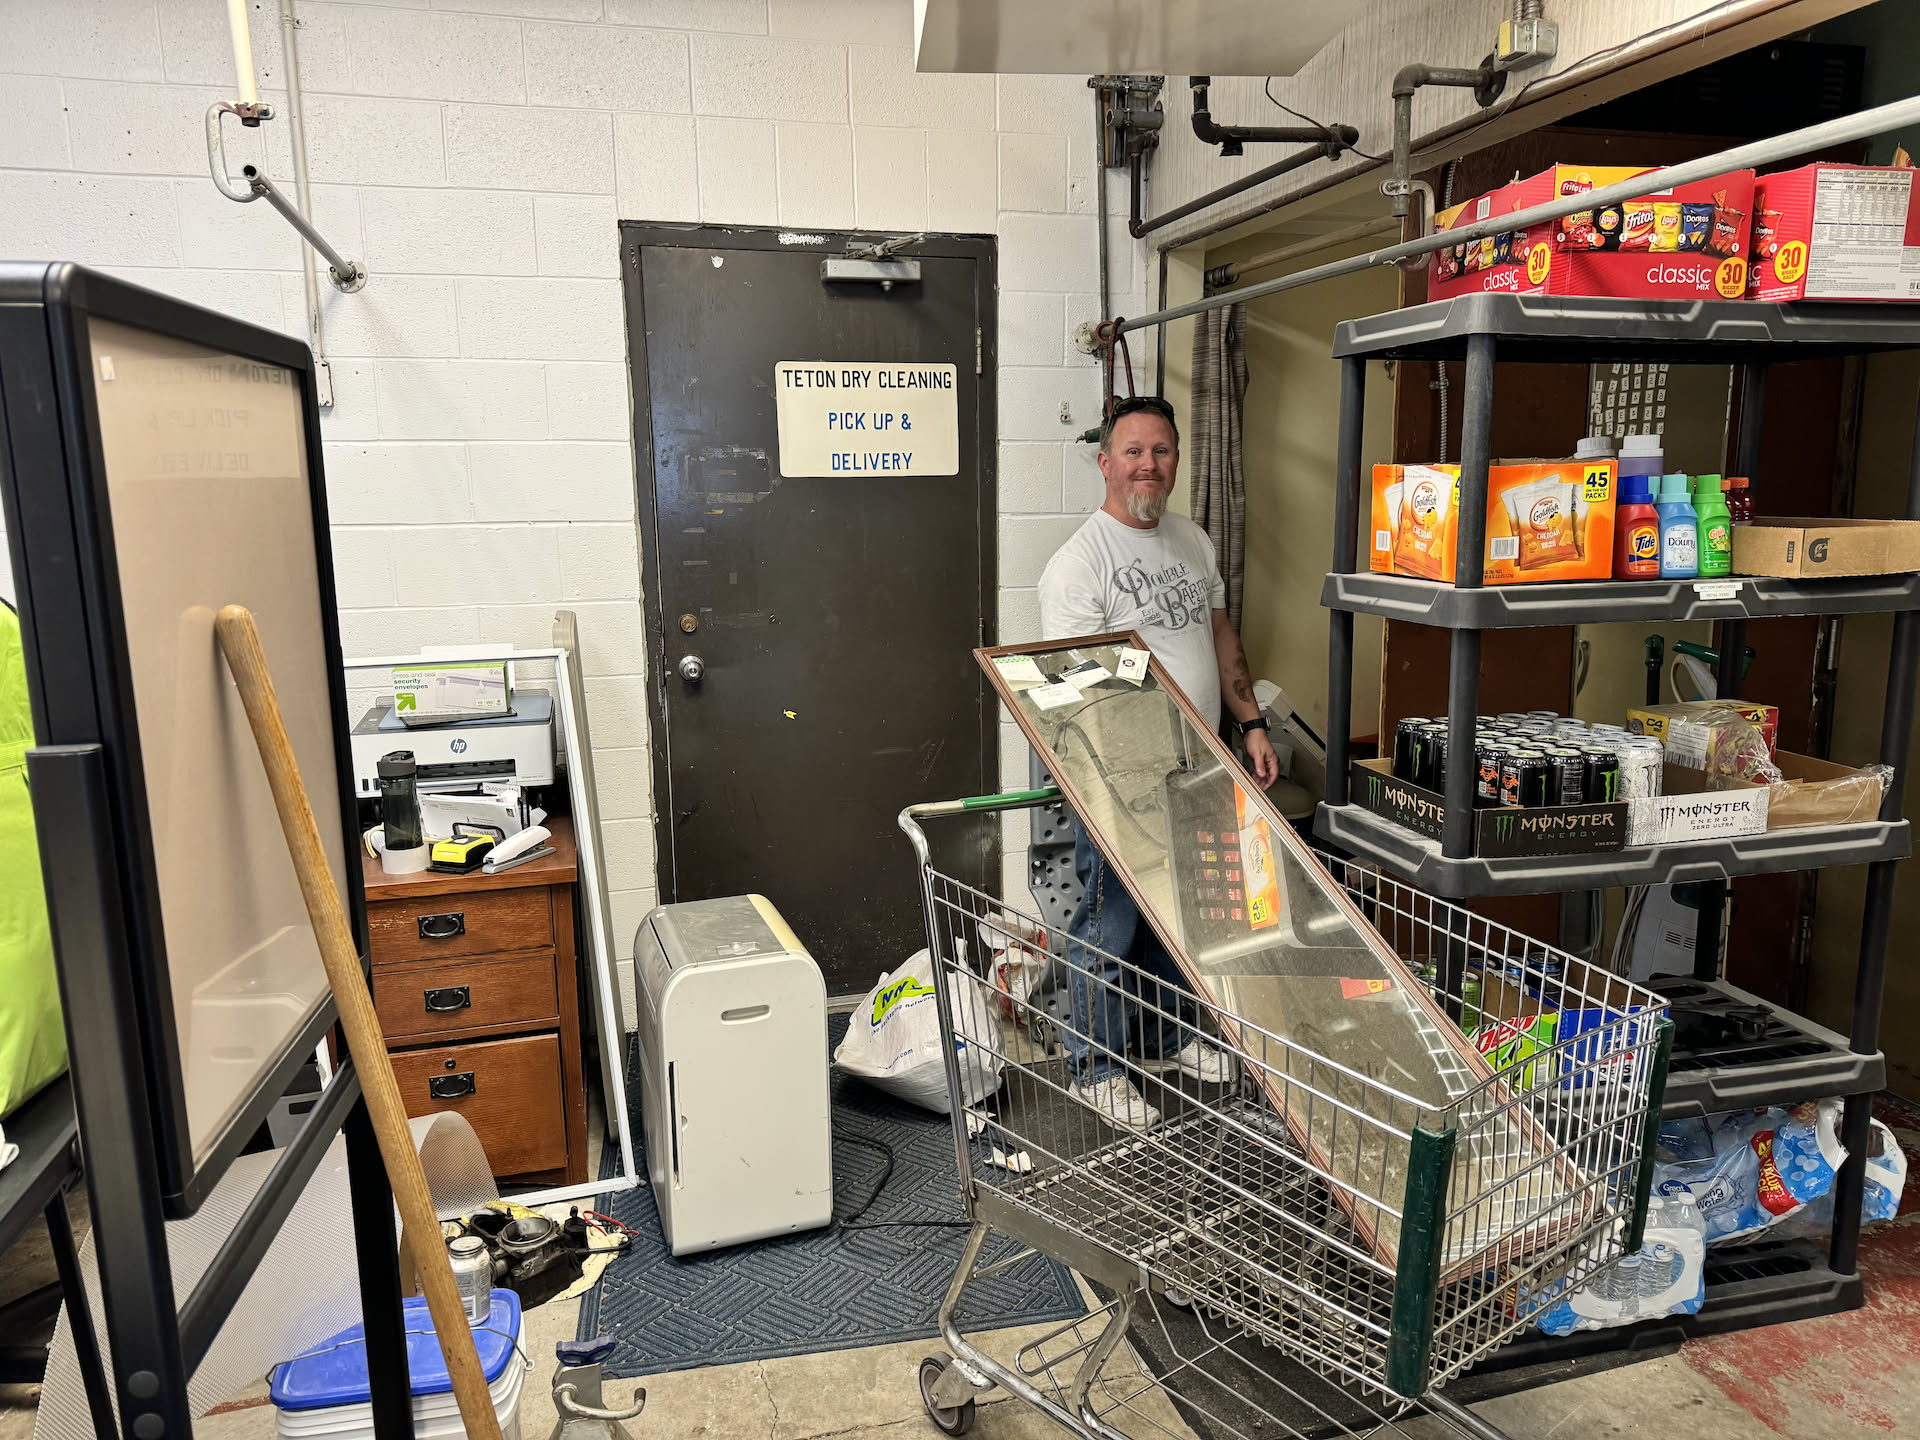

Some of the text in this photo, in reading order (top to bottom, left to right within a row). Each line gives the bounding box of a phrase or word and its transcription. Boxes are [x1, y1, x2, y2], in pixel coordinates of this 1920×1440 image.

[1627, 211, 1656, 230] Fritos
[1686, 214, 1710, 222] Doritos
[1716, 222, 1737, 234] Doritos
[1755, 226, 1774, 235] Doritos
[1532, 248, 1546, 272] 30
[1780, 246, 1801, 270] 30
[1483, 266, 1520, 291] classic
[1647, 263, 1712, 284] classic
[1722, 264, 1743, 285] 30
[1696, 283, 1710, 291] MIX
[782, 370, 952, 389] TETON DRY CLEANING
[828, 412, 912, 430] PICK UP &
[832, 452, 912, 471] DELIVERY
[1586, 472, 1608, 488] 45
[1414, 494, 1437, 508] Goldfish
[1532, 503, 1560, 522] Goldfish
[1536, 528, 1560, 540] CHEDDAR
[1708, 528, 1726, 539] Gain
[1635, 535, 1656, 552] Tide
[1668, 537, 1696, 550] Downy
[1646, 718, 1663, 729] C4
[453, 738, 465, 754] hp
[1384, 786, 1444, 823] MONSTE
[1678, 801, 1750, 818] MONSTER
[1396, 811, 1442, 836] ENERGY
[1520, 812, 1616, 832] MONSTER
[1690, 816, 1736, 824] ENERGY
[1536, 830, 1598, 840] ENERGY
[1764, 1159, 1780, 1192] VALUE
[1663, 1184, 1686, 1193] Great
